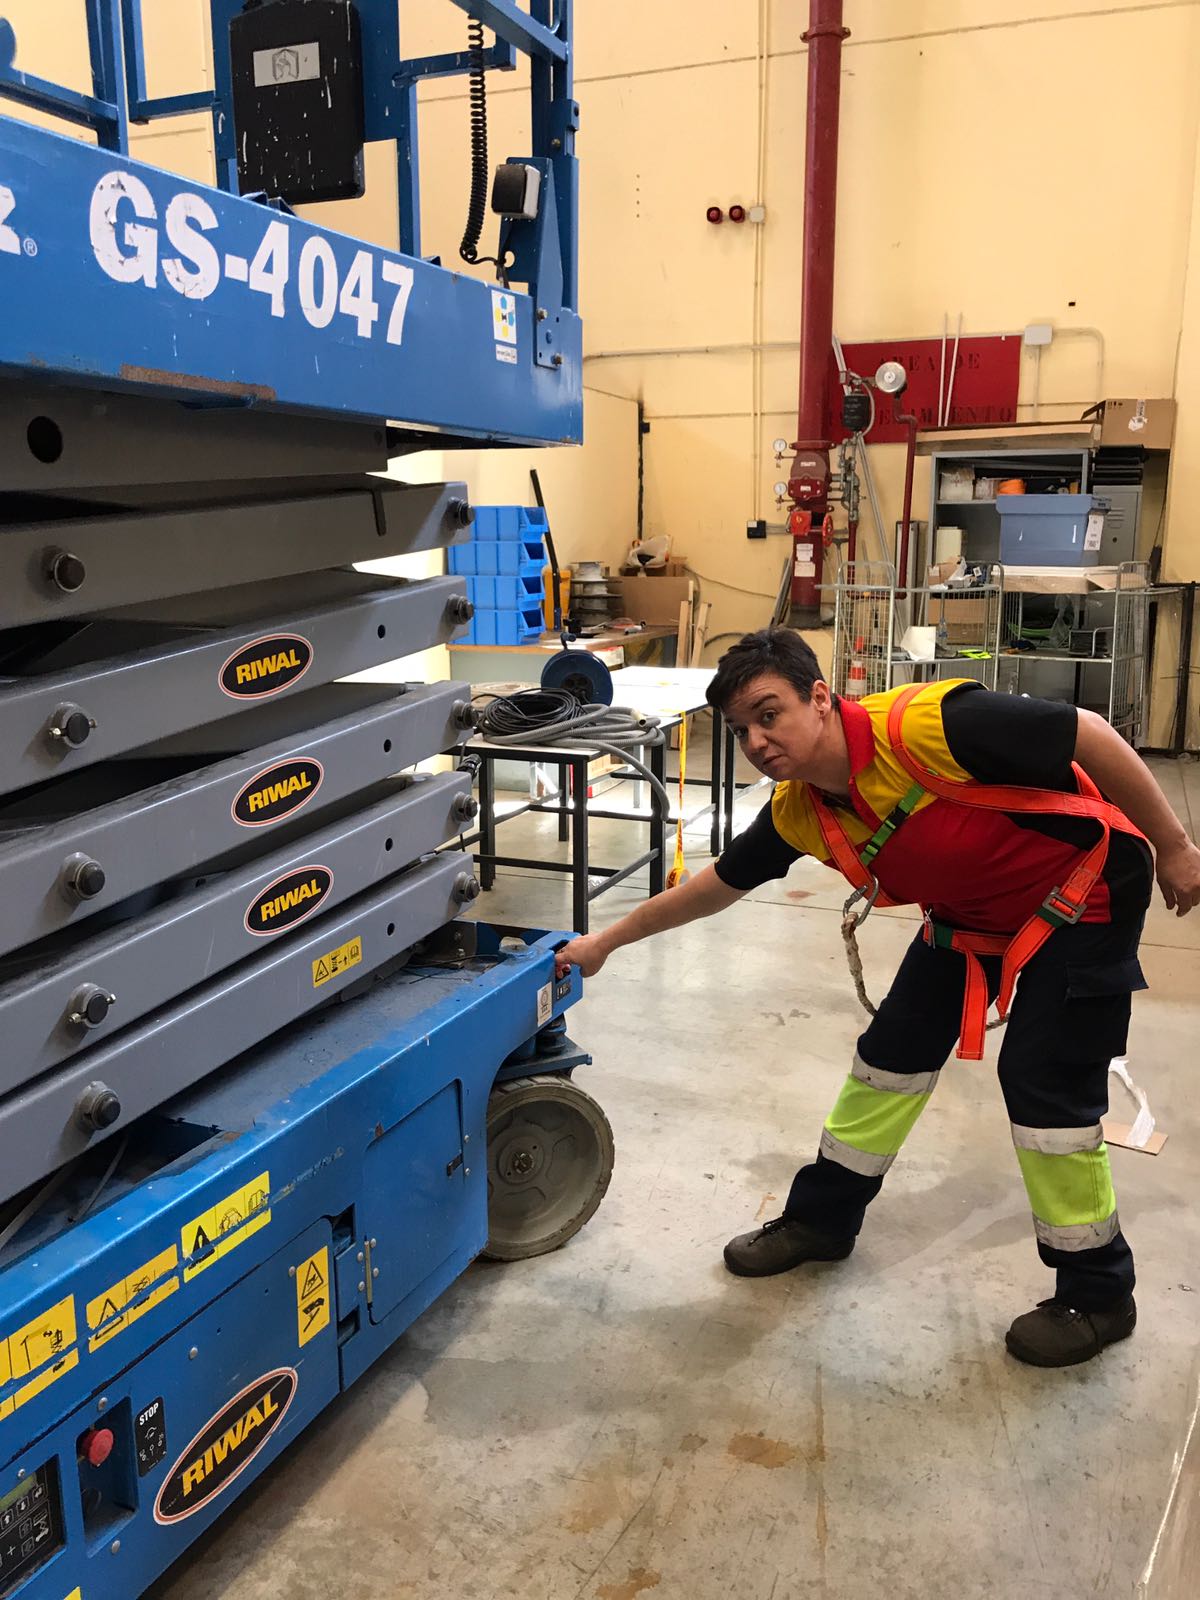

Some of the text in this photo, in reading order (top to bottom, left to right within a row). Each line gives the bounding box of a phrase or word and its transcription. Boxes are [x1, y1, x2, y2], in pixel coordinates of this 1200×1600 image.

[90, 171, 414, 345] GS-4047
[236, 649, 300, 684] RIWAL
[248, 772, 311, 812] RIWAL
[261, 880, 321, 921] RIWAL
[139, 1403, 159, 1426] STOP
[182, 1393, 279, 1496] RIWAL
